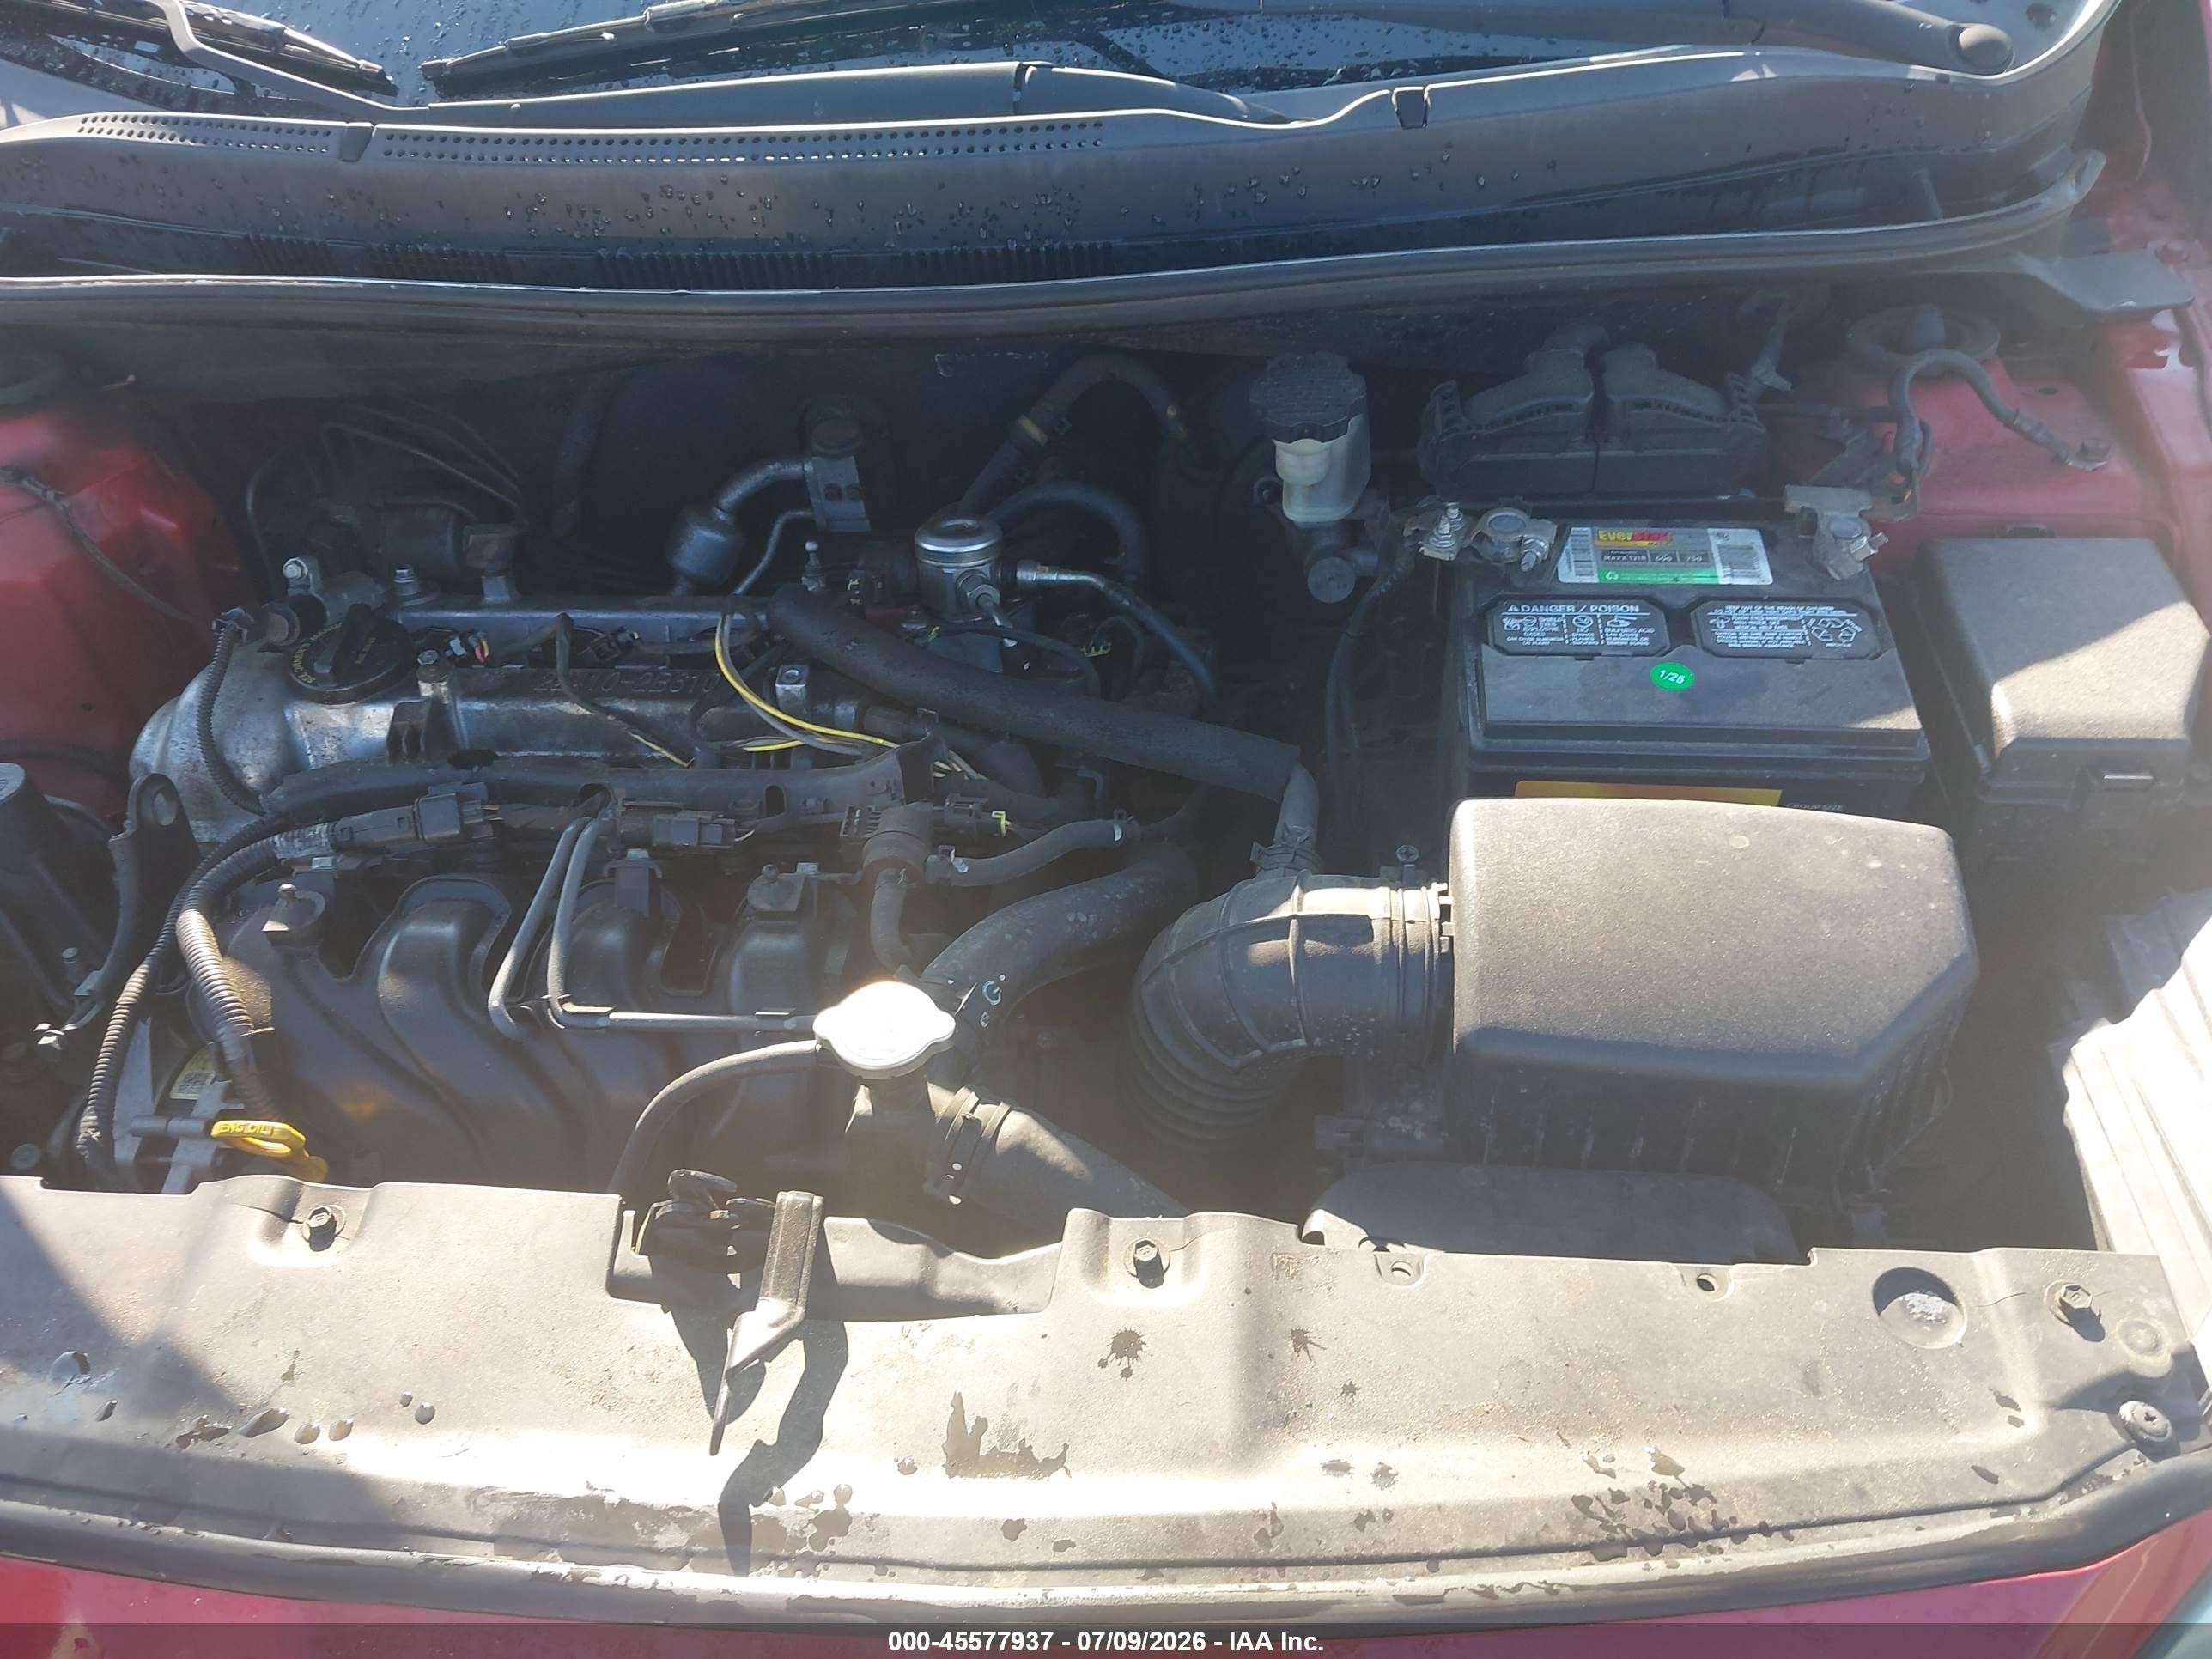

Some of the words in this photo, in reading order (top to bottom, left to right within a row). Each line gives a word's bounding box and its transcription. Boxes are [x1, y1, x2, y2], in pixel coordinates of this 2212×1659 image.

[1521, 605, 1575, 613] DANGER
[1578, 605, 1588, 613] /
[1589, 605, 1639, 613] POISON
